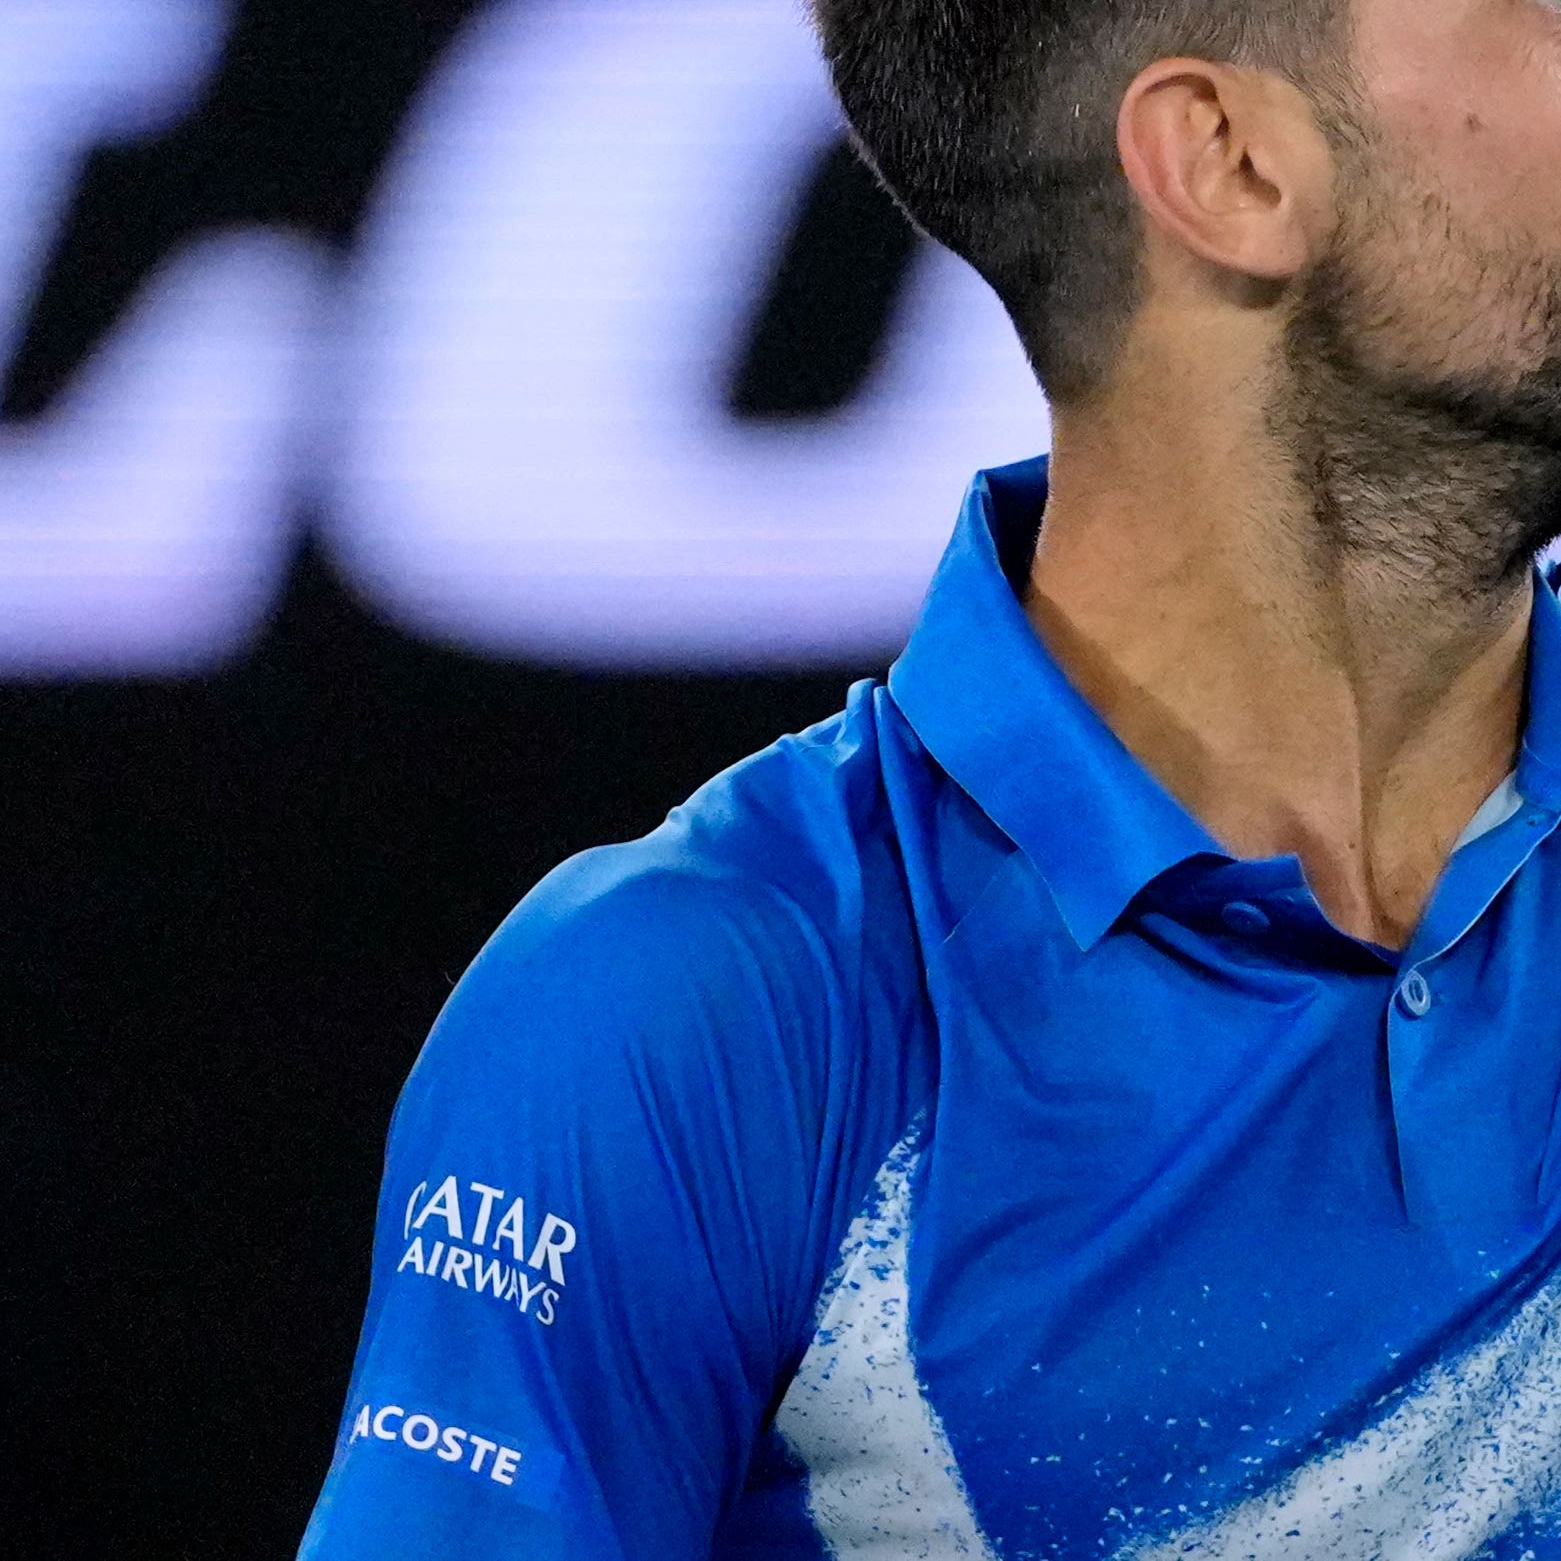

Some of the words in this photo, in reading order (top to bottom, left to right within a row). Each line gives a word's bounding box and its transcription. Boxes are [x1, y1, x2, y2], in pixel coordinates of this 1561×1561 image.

[402, 1174, 578, 1287] ATAR
[396, 1236, 560, 1326] AIRWAYS
[350, 1404, 522, 1486] ACOSTE
